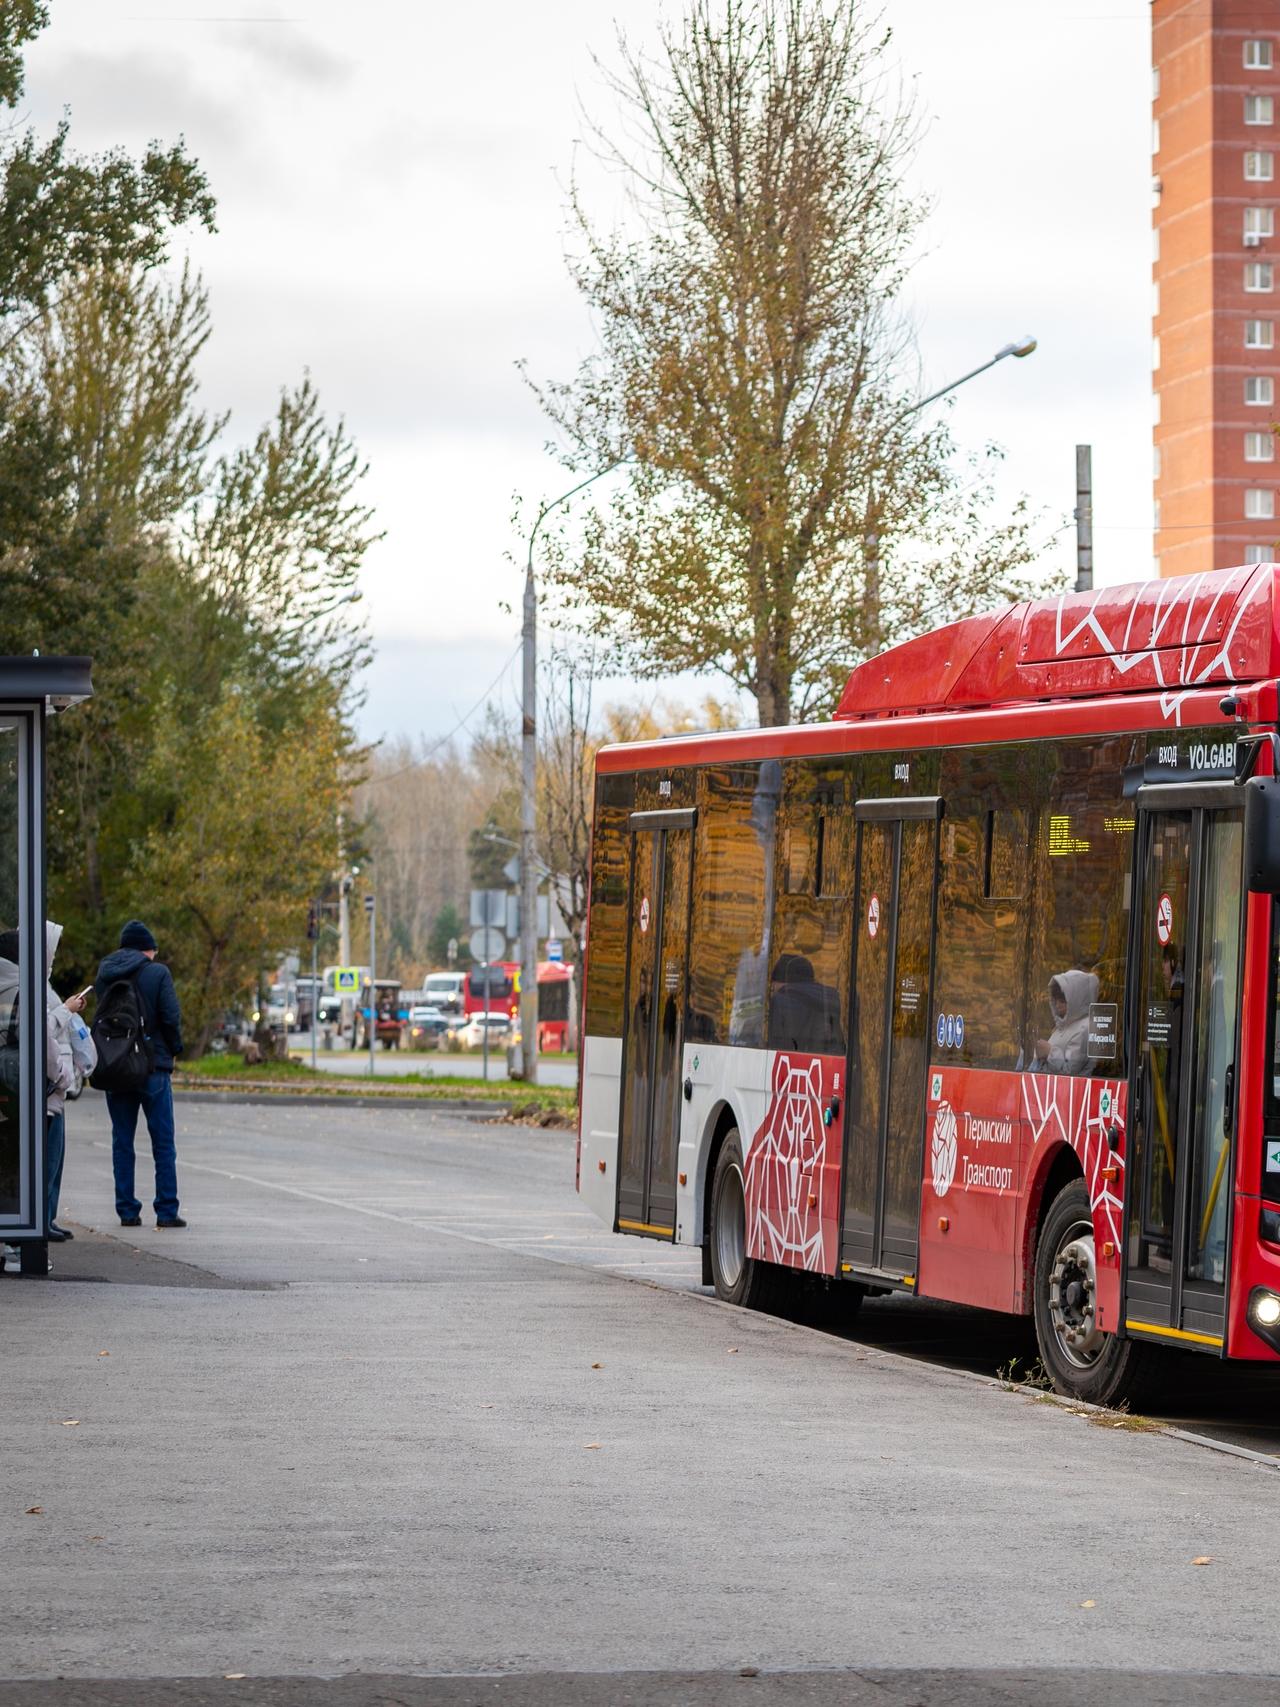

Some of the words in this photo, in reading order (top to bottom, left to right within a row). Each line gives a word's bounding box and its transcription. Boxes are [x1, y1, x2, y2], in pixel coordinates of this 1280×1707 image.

[1158, 745, 1177, 767] ВХОД
[964, 1111, 1012, 1149] Пермский
[962, 1155, 1013, 1196] Транспорт
